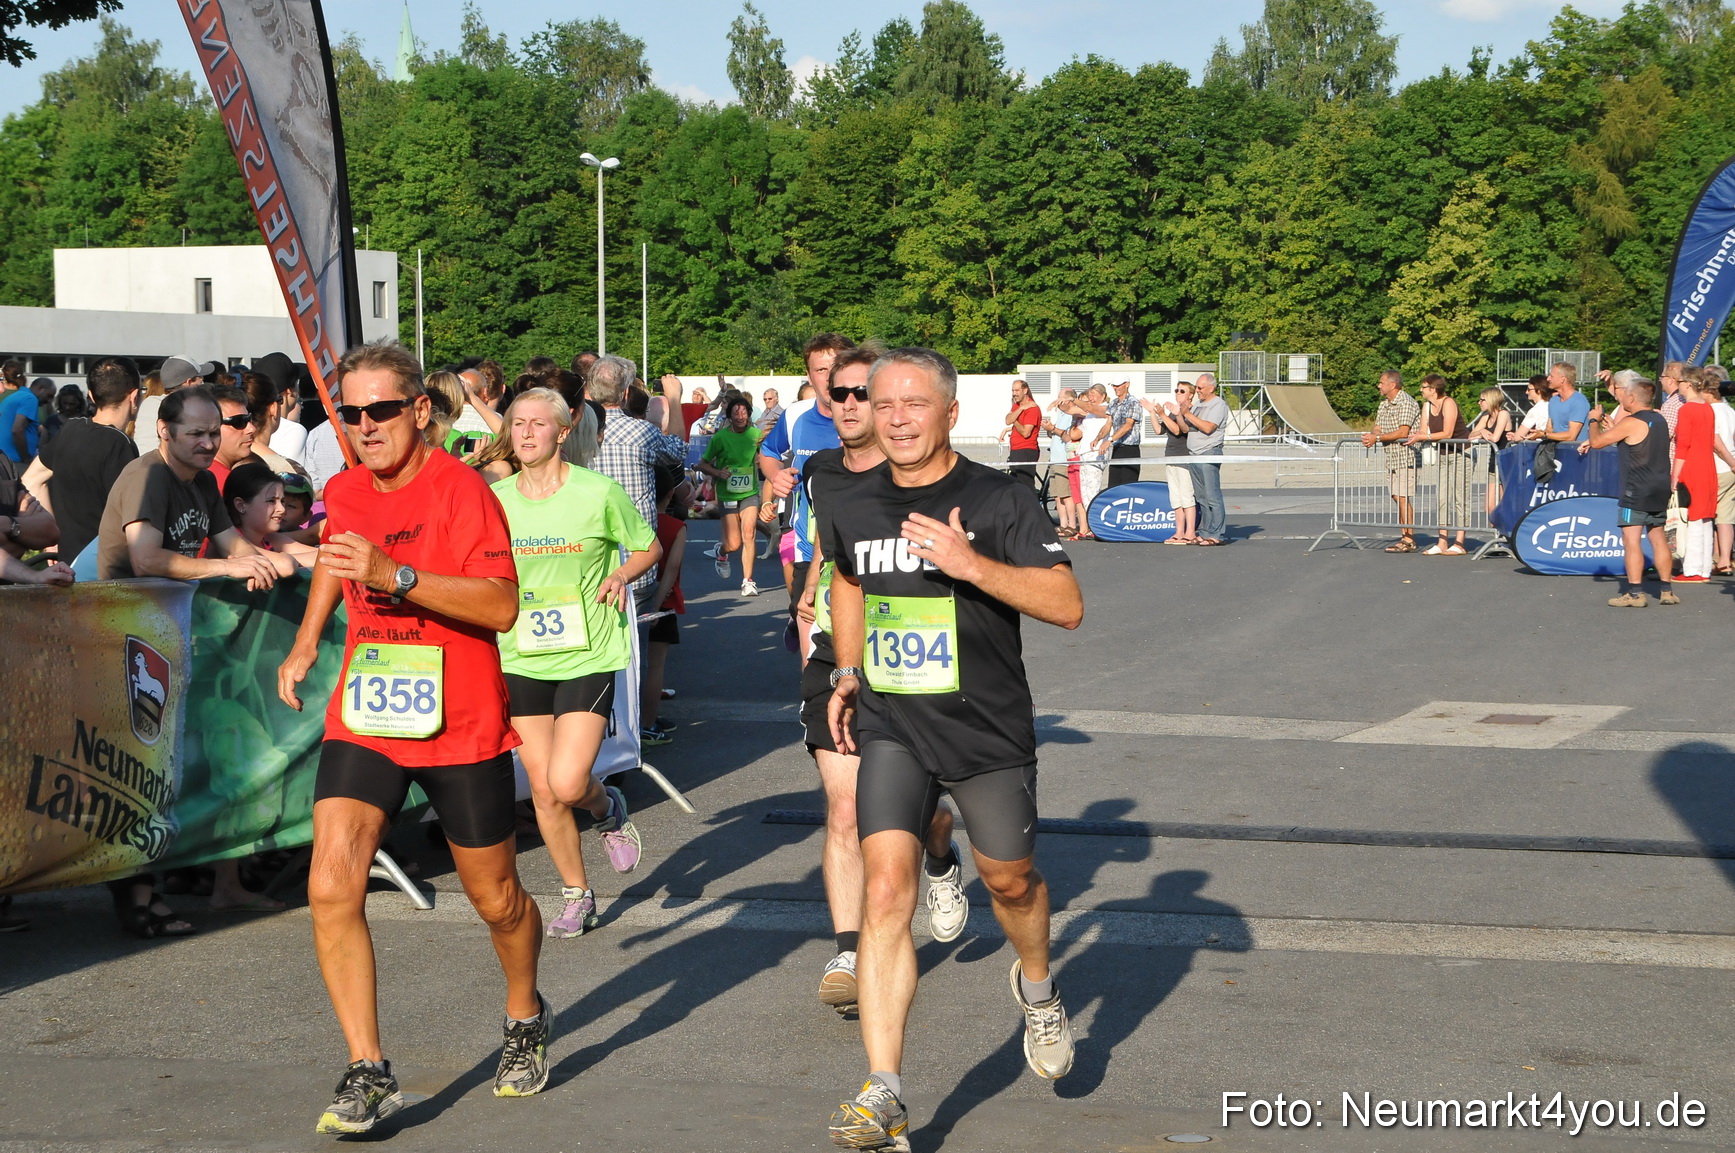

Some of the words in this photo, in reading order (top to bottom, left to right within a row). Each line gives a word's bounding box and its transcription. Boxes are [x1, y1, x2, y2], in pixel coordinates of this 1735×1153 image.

[730, 475, 750, 487] 570
[515, 543, 583, 556] neumarkt
[530, 609, 565, 637] 33
[387, 628, 422, 641] läuft
[867, 630, 953, 669] 1394
[347, 675, 436, 714] 1358
[136, 713, 154, 737] 1628
[364, 714, 389, 722] Wolfgang
